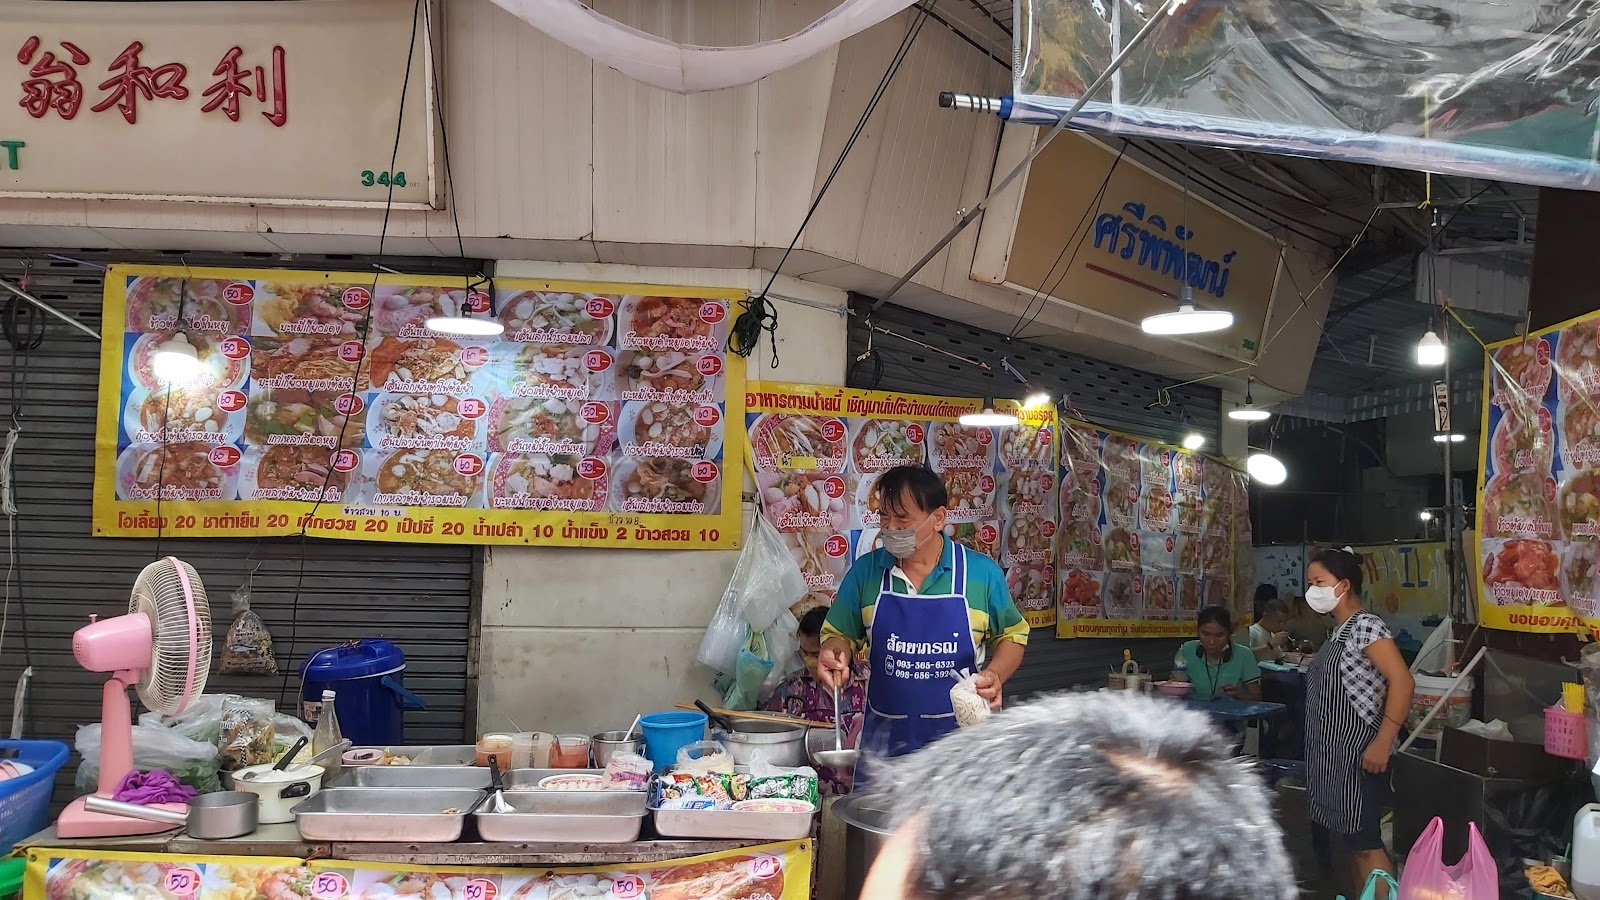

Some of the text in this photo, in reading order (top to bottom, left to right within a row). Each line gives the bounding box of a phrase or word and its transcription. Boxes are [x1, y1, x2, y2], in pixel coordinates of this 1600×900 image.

[17, 35, 288, 127] 翁和利
[361, 170, 407, 187] 344
[745, 390, 844, 412] อาหารตามป้ายนี้
[118, 509, 168, 529] โอเลี้ยง
[175, 515, 196, 528] 20
[203, 511, 260, 529] ชาดำเย็น
[267, 514, 289, 528] 20
[296, 513, 357, 531] เก๊กฮวย
[364, 519, 388, 532] 20
[442, 522, 465, 536] 20
[473, 516, 524, 537] น้ำเปล่า
[533, 524, 555, 538] 10
[562, 519, 608, 539] น้ำแข็ง
[616, 527, 628, 540] 2
[635, 524, 691, 542] ข้าวสวย
[700, 529, 720, 542] 10
[895, 669, 952, 679] 098-656-392
[896, 660, 955, 669] 093-365-6323
